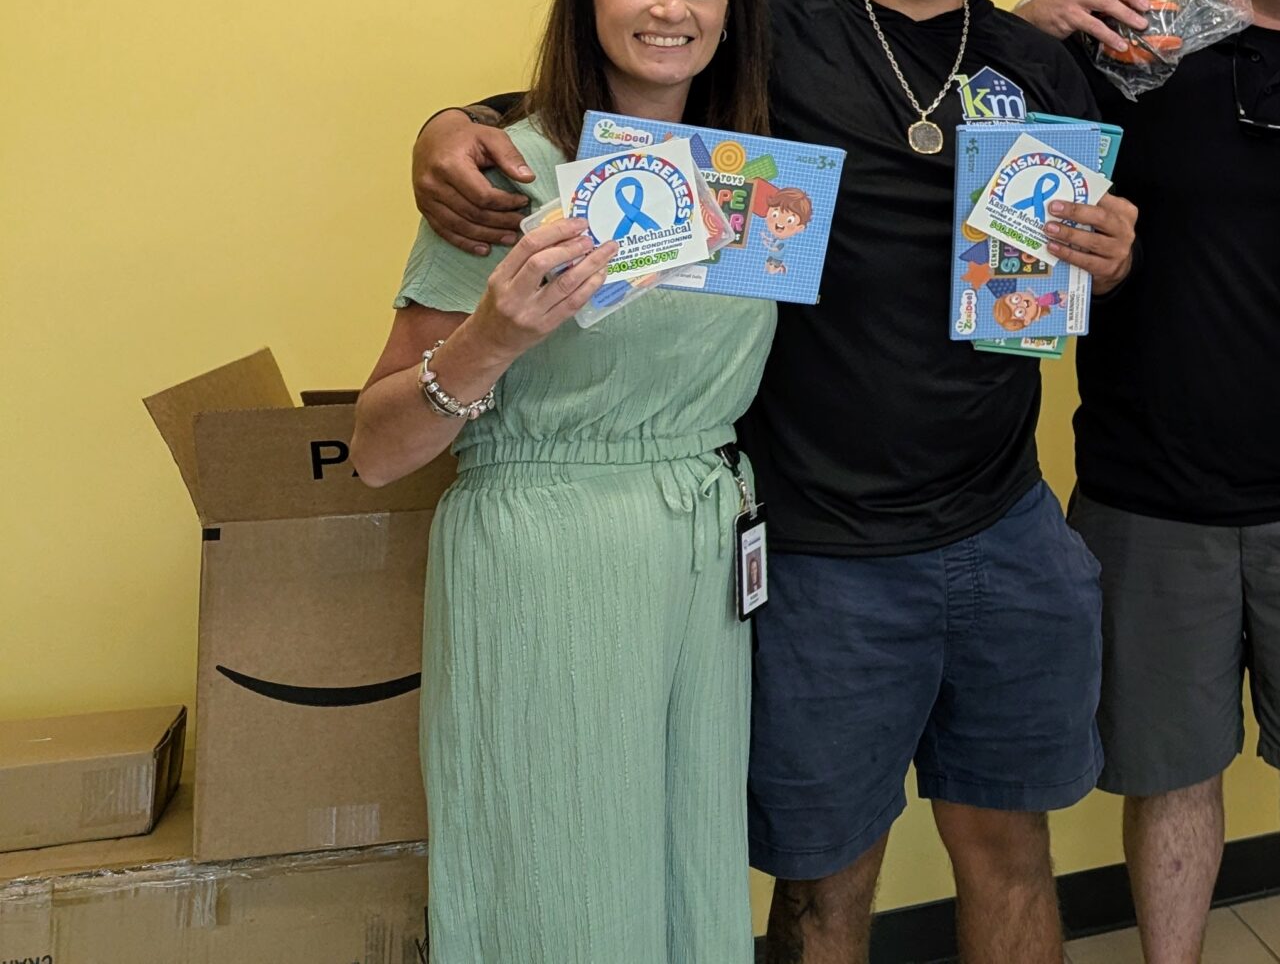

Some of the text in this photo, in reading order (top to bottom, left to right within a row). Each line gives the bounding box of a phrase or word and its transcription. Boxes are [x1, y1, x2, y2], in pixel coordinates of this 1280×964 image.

[954, 74, 1026, 120] km
[966, 137, 979, 155] 3+
[816, 155, 836, 170] 3+
[604, 156, 691, 219] AWARENESS
[720, 173, 744, 185] TOYS
[994, 155, 1041, 200] AUTISM
[989, 197, 1018, 217] Kasper
[626, 221, 692, 247] Mechanical
[628, 246, 640, 254] AIR
[641, 234, 693, 250] CONDITIONING
